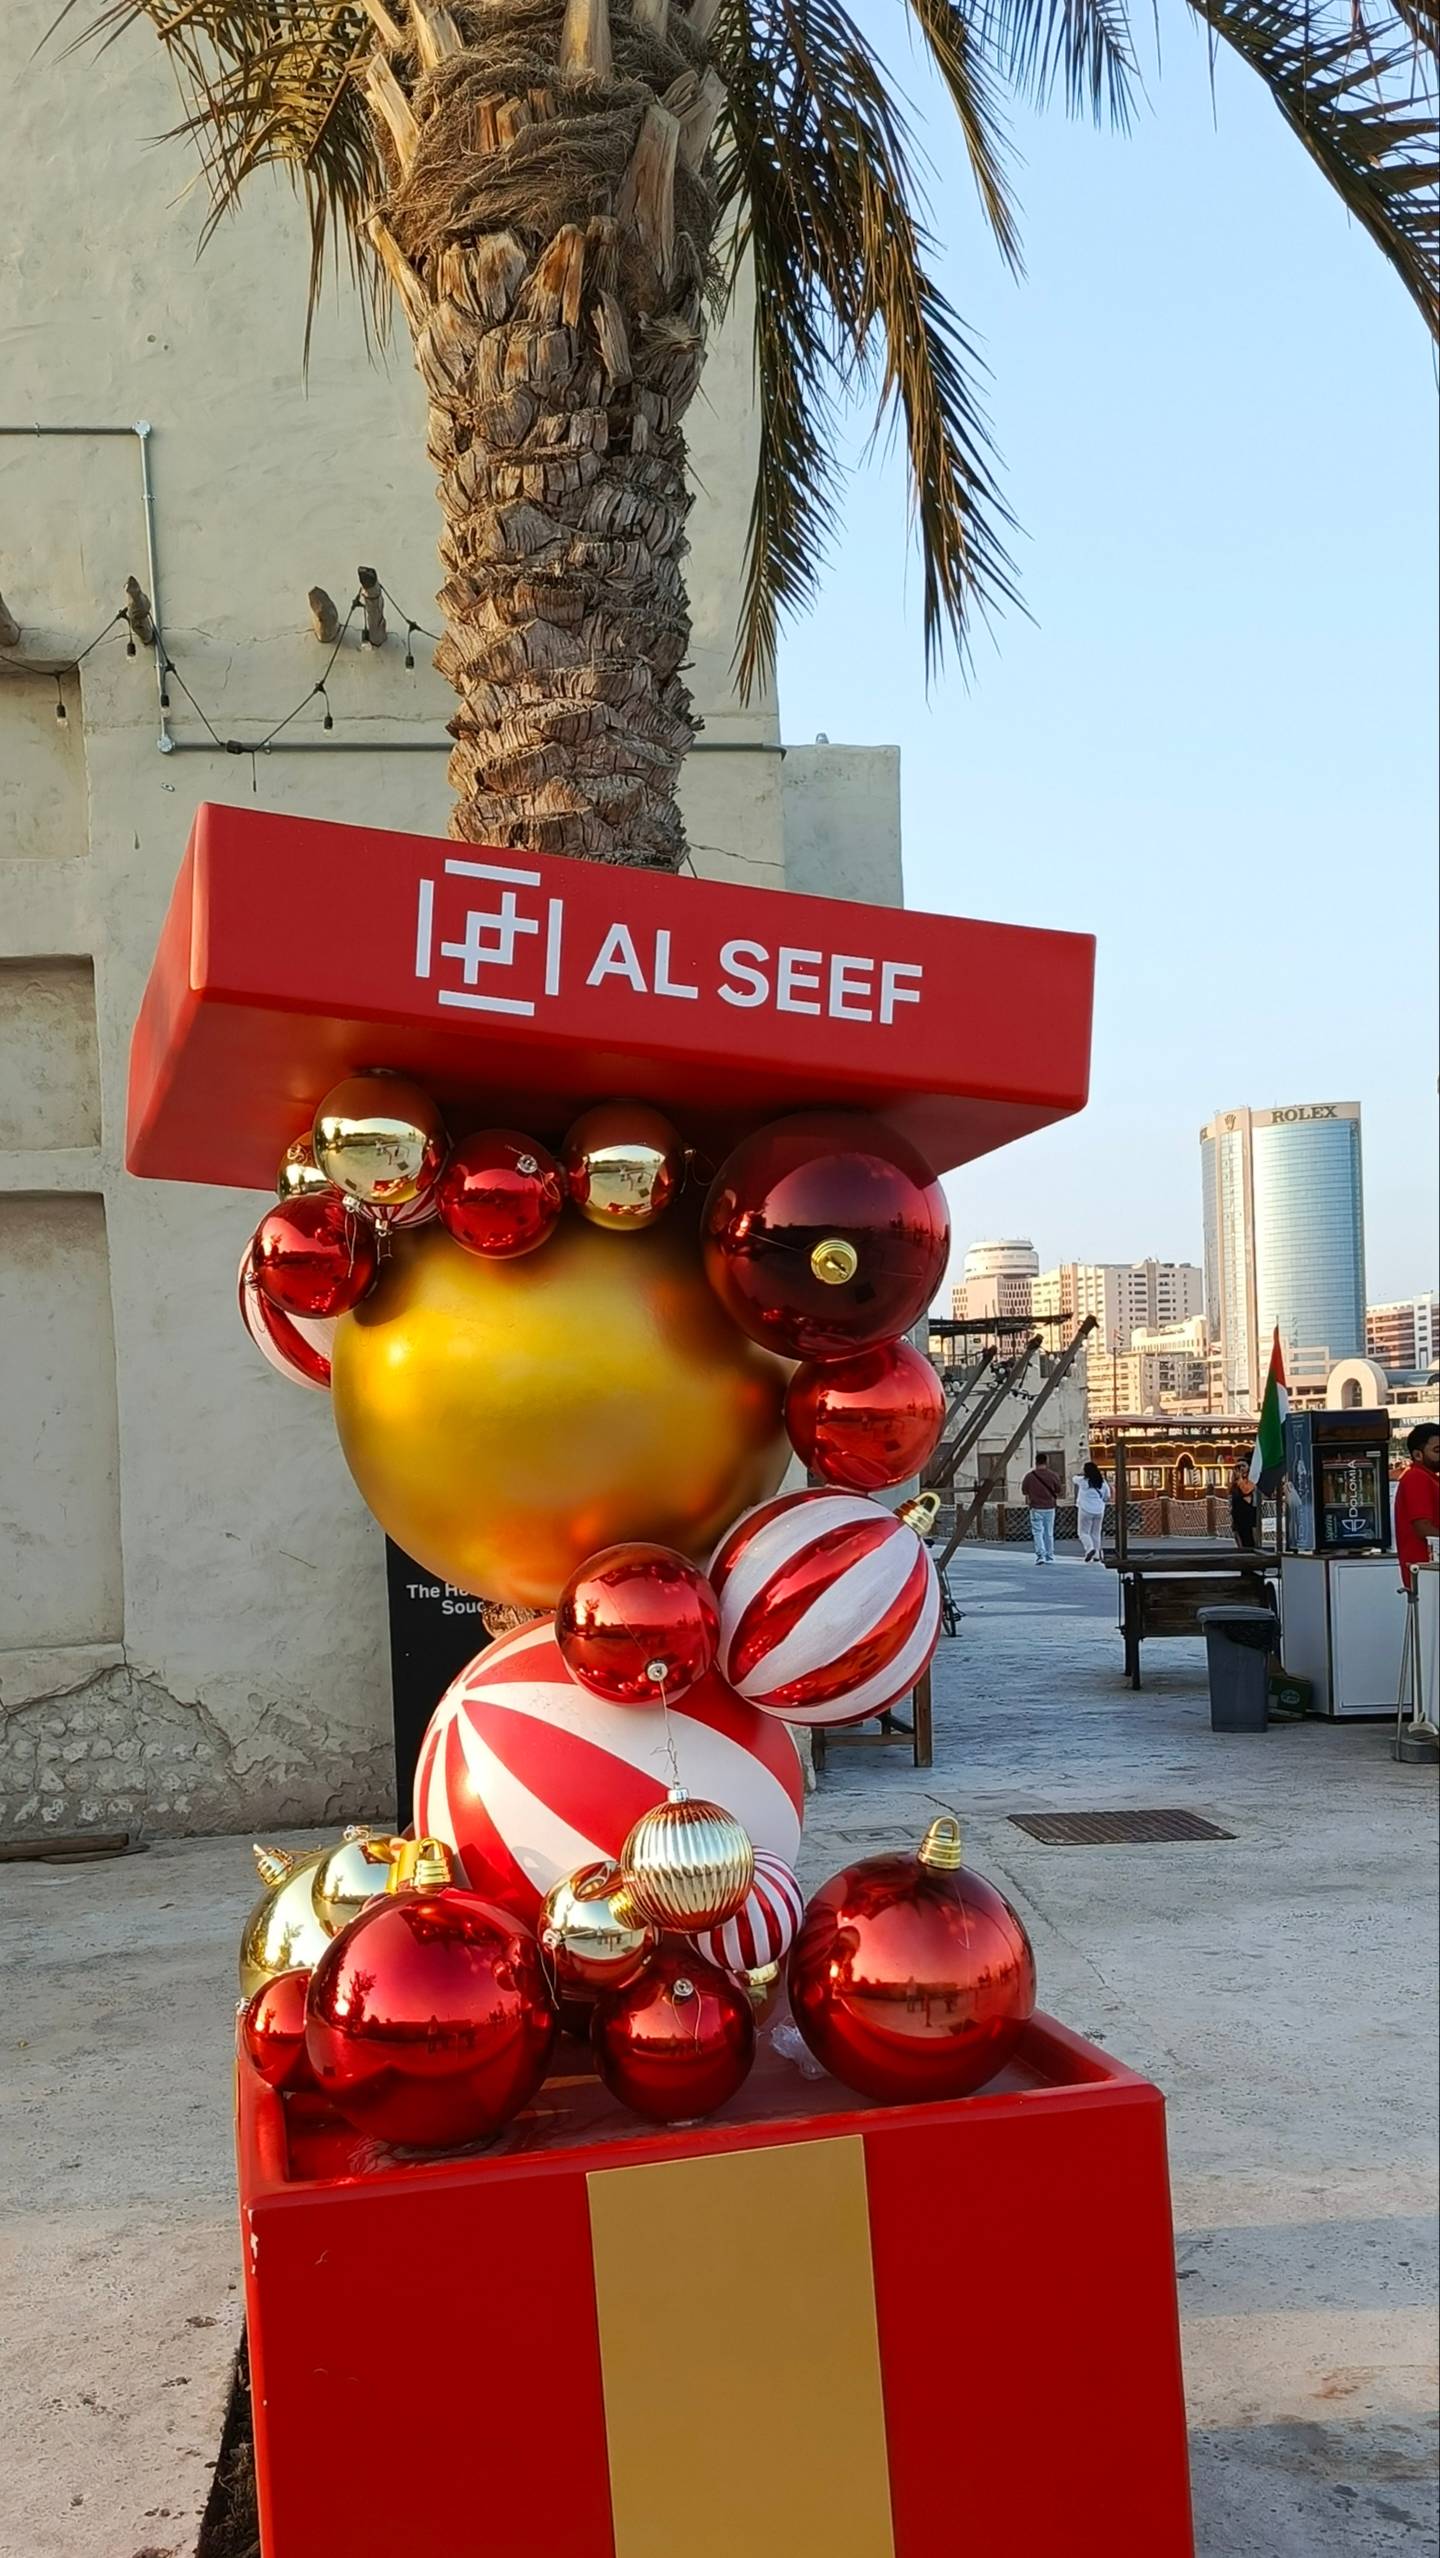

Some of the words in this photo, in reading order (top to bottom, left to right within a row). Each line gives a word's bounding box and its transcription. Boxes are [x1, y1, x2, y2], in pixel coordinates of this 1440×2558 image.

[586, 923, 698, 1000] AL
[717, 940, 923, 1024] SEEF
[1272, 1106, 1337, 1122] ROLEX
[1348, 1460, 1358, 1518] DOLOMIA
[406, 1584, 440, 1598] The
